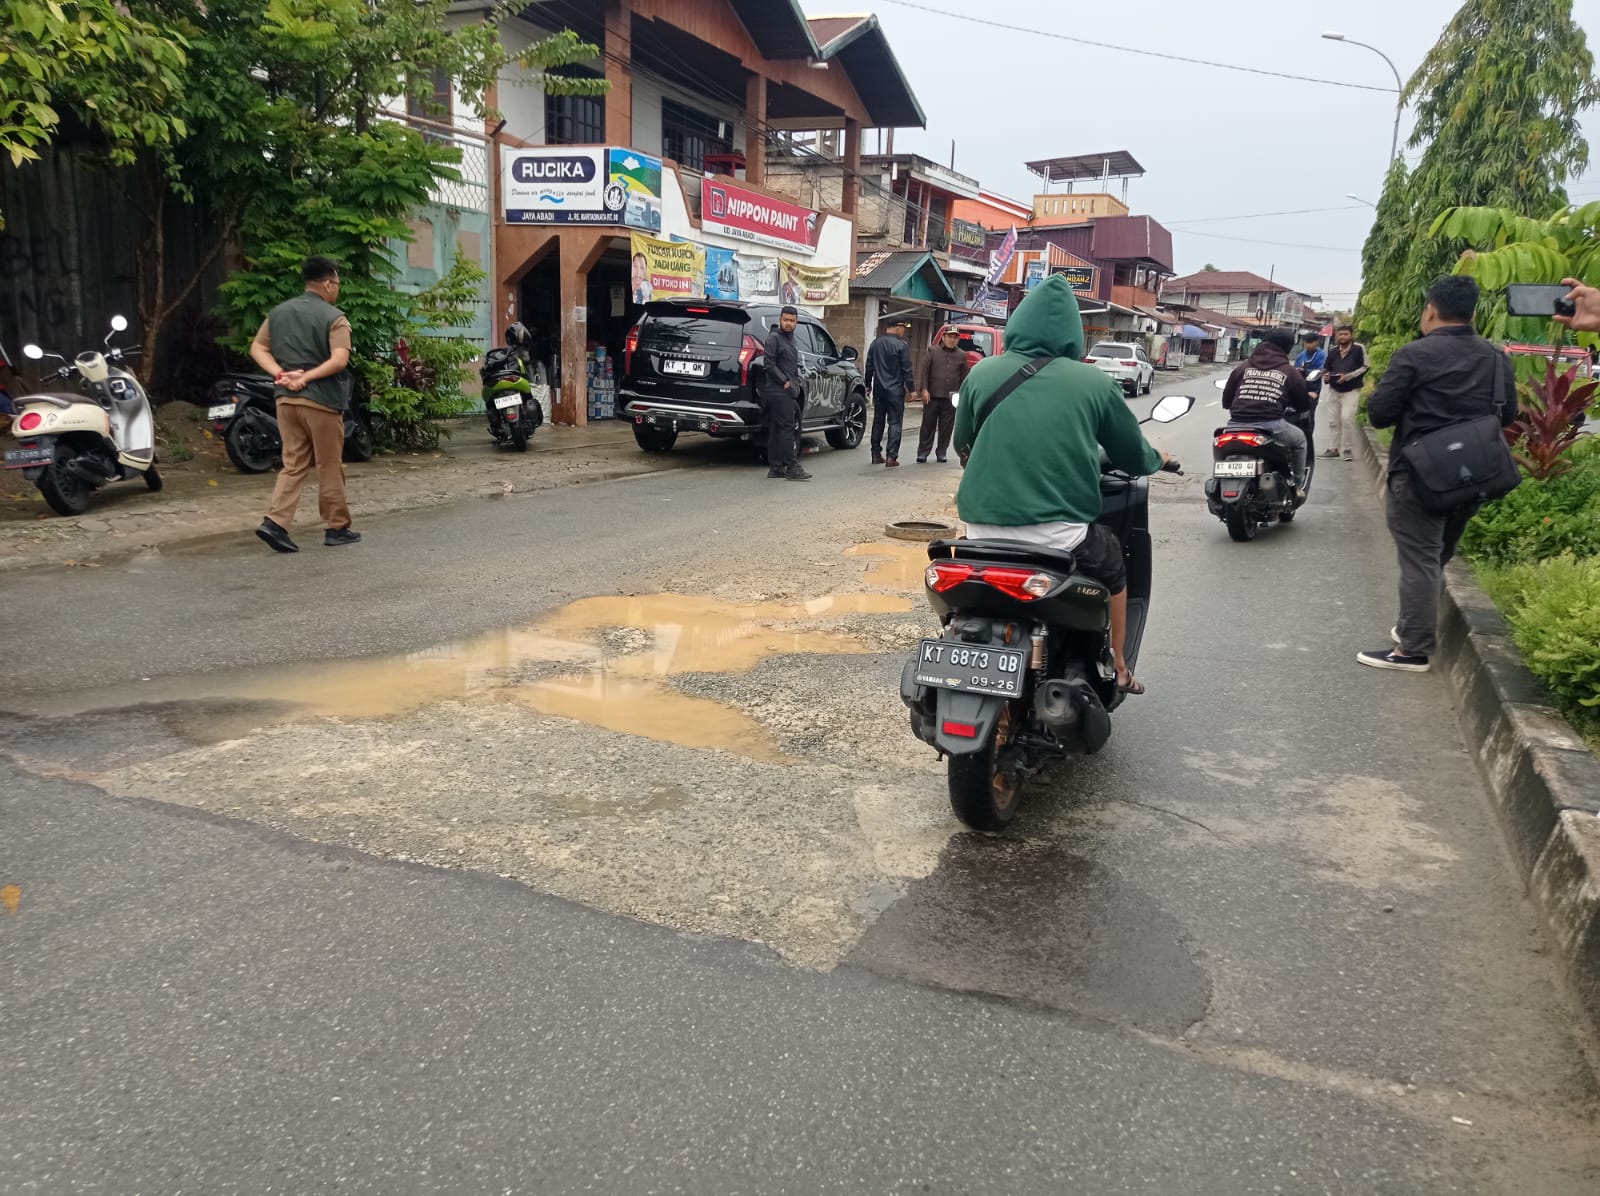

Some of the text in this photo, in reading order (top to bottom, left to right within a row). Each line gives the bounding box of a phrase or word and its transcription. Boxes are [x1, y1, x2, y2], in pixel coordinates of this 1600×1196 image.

[521, 162, 585, 178] RUCIKA
[521, 212, 536, 220] JAYA
[536, 212, 555, 220] ABADI
[727, 198, 799, 232] NIPPON PAINT
[647, 244, 671, 257] TUKAR
[653, 259, 691, 272] JADI UANG
[653, 277, 691, 289] DI TOKO INI
[665, 360, 676, 369] KT
[683, 362, 687, 370] 1
[924, 645, 1019, 673] KT 6873 QB
